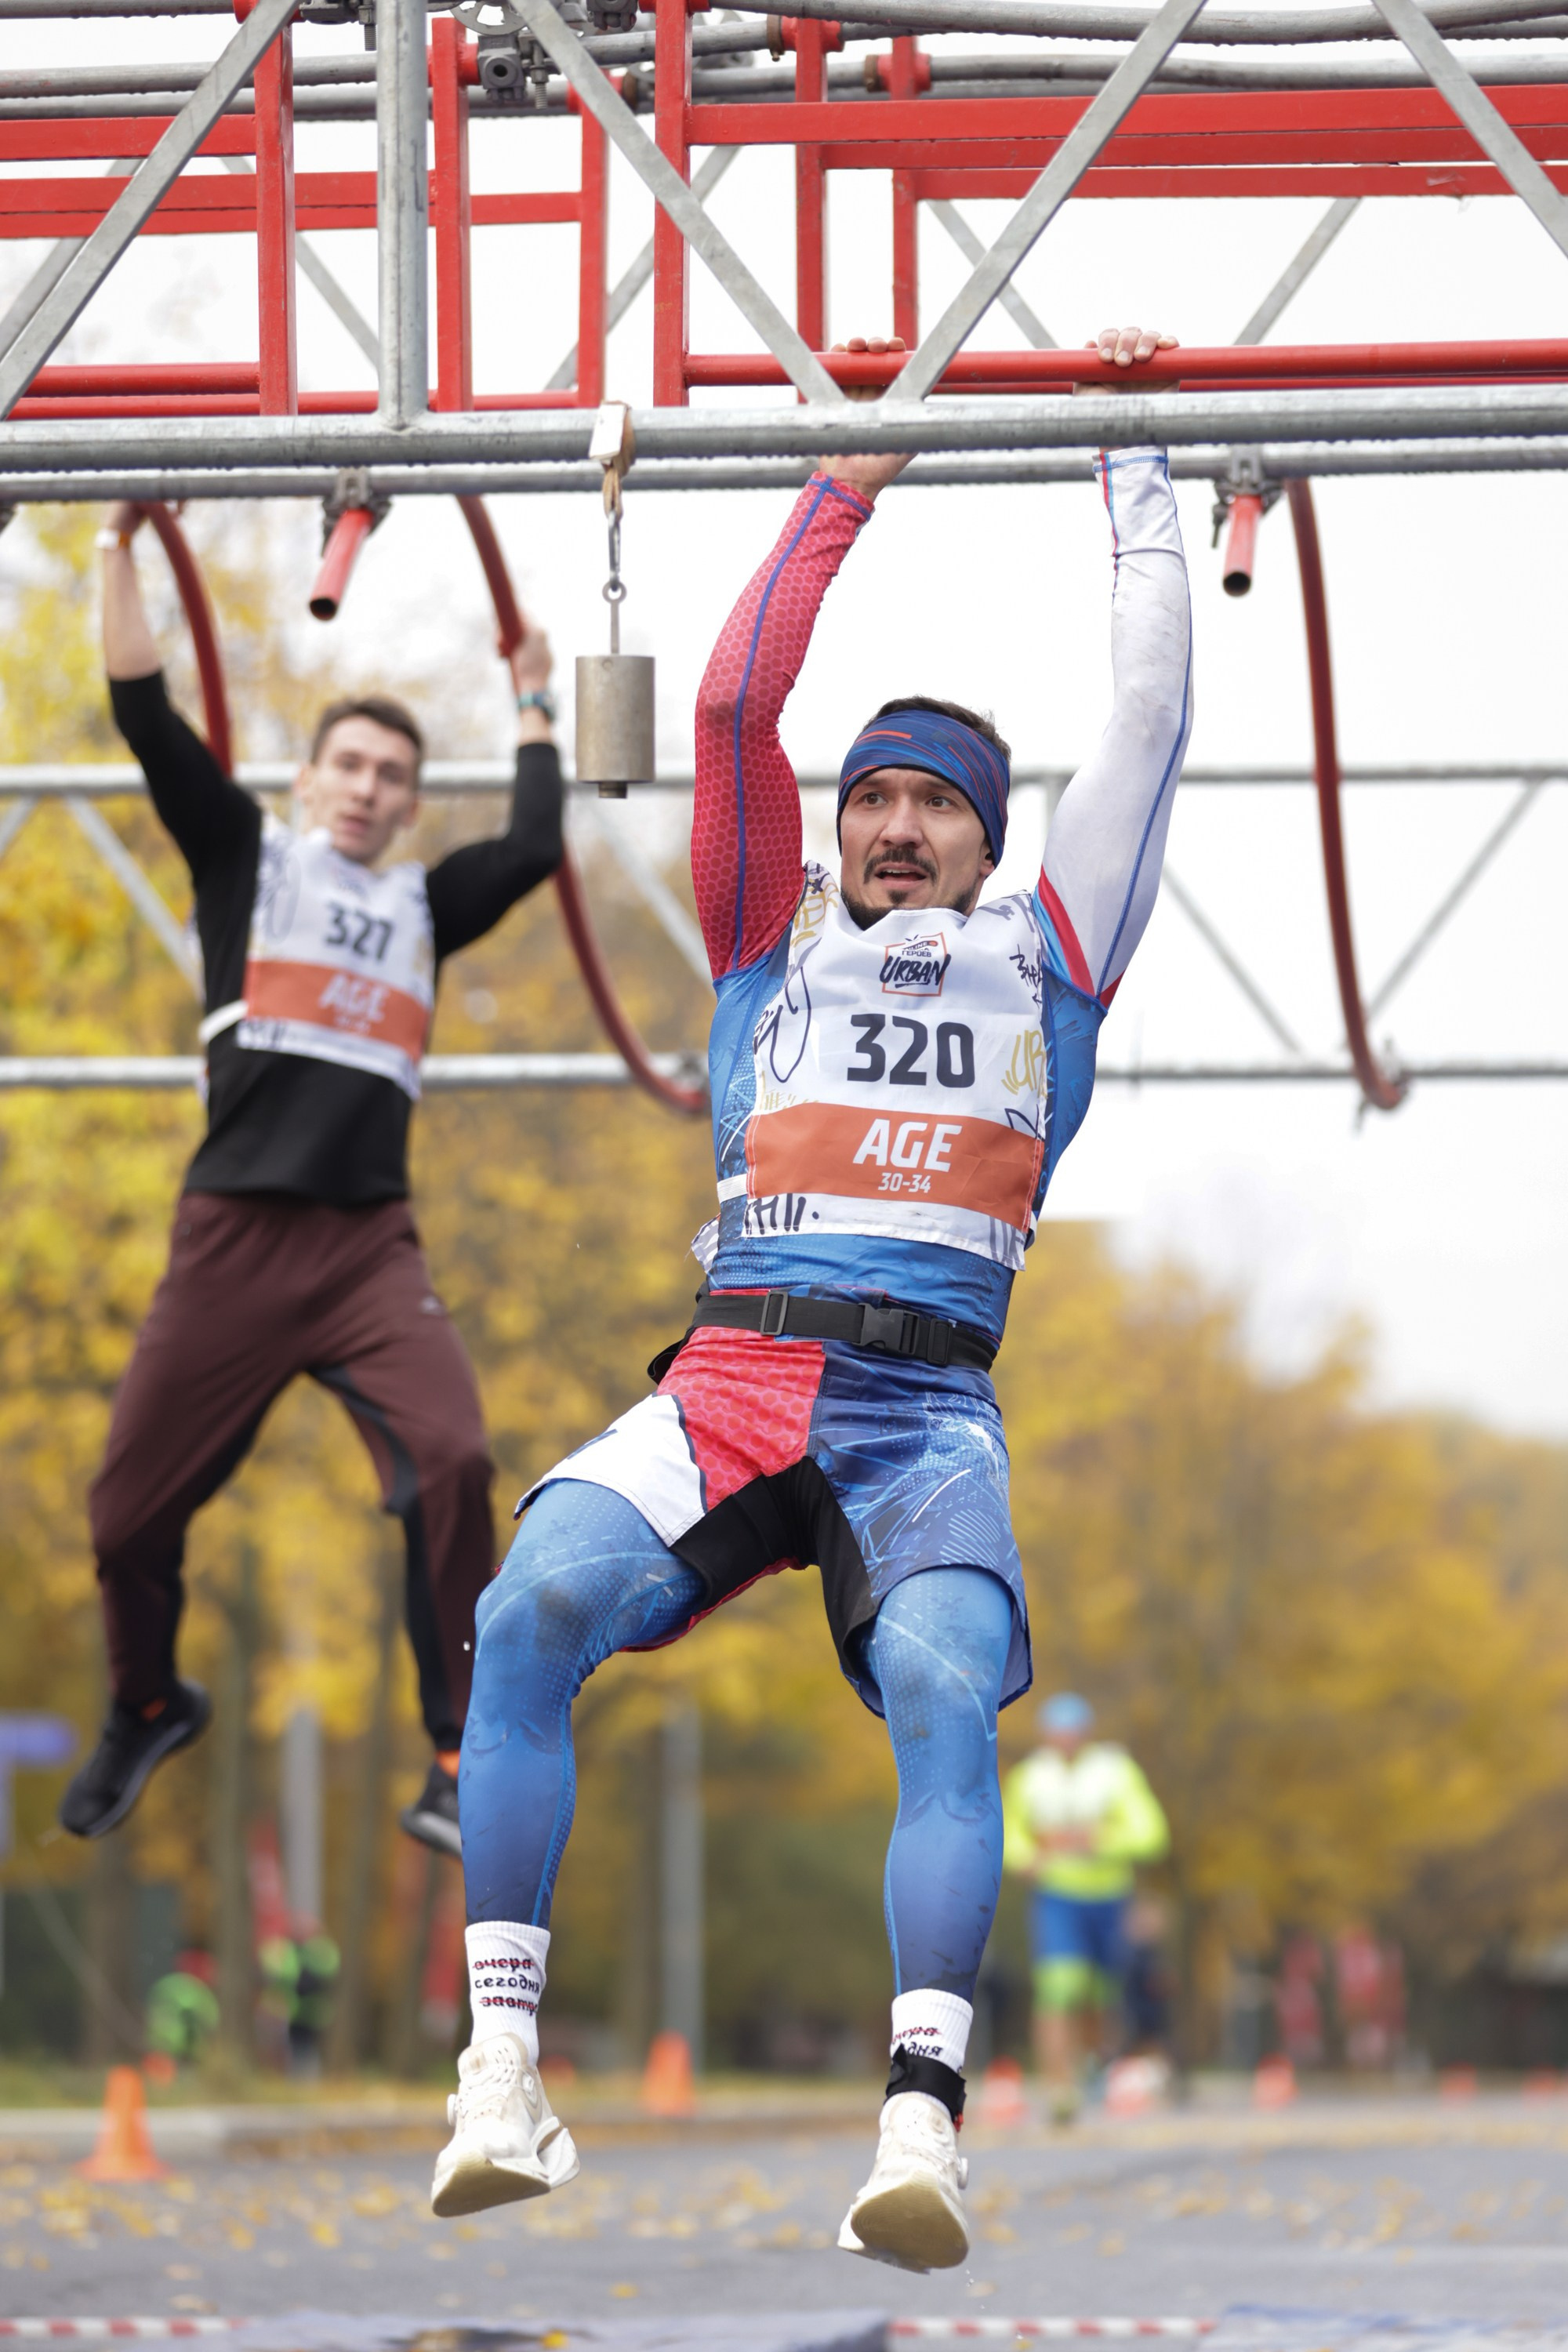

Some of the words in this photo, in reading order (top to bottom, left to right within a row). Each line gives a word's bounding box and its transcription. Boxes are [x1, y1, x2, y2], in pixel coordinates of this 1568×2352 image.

[325, 901, 394, 963] 327
[880, 953, 951, 985] URBAN
[318, 974, 394, 1022] AGE
[847, 1013, 976, 1088] 320
[852, 1118, 963, 1173] AGE
[877, 1172, 931, 1194] 30-34
[474, 1974, 540, 1994] сегодня
